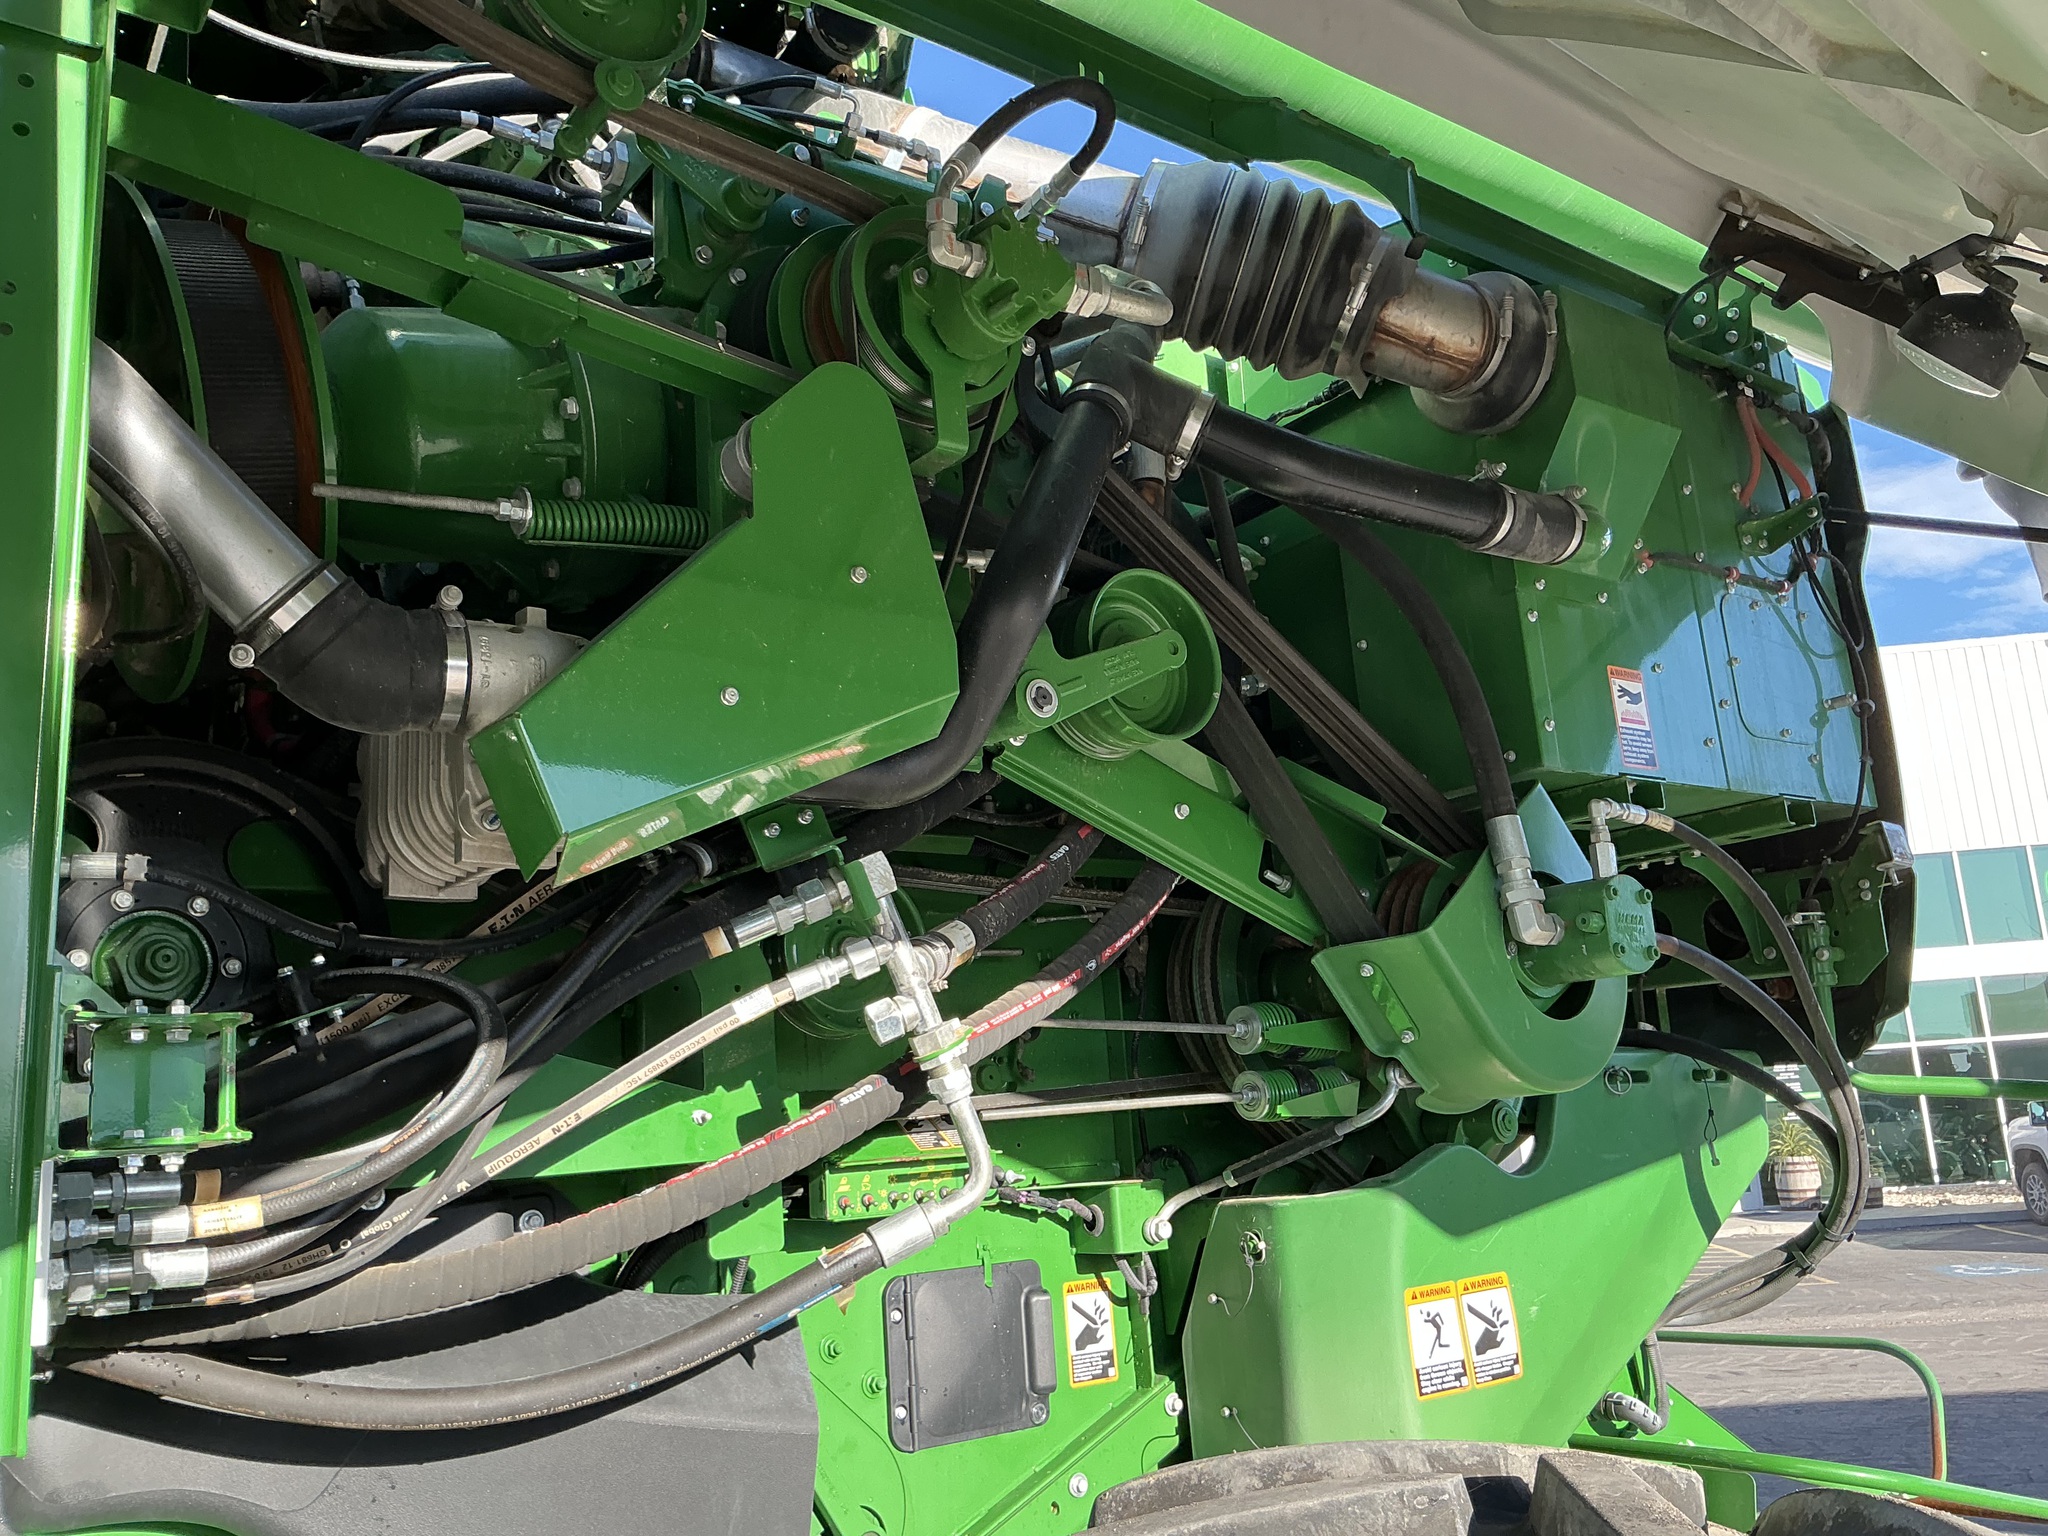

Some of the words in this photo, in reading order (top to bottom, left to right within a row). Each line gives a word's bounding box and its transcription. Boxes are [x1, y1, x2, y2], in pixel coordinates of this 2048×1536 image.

[1614, 669, 1642, 681] WARNING
[528, 884, 554, 908] AER
[432, 957, 457, 973] N857
[713, 1020, 728, 1035] psi)
[669, 1035, 707, 1062] EXCEEDS
[643, 1058, 669, 1077] EN857
[487, 1137, 541, 1174] AEROQUIP
[359, 1220, 393, 1239] Global
[1074, 1280, 1108, 1292] WARNING
[1470, 1276, 1504, 1290] WARNING
[1419, 1286, 1451, 1299] WARNING
